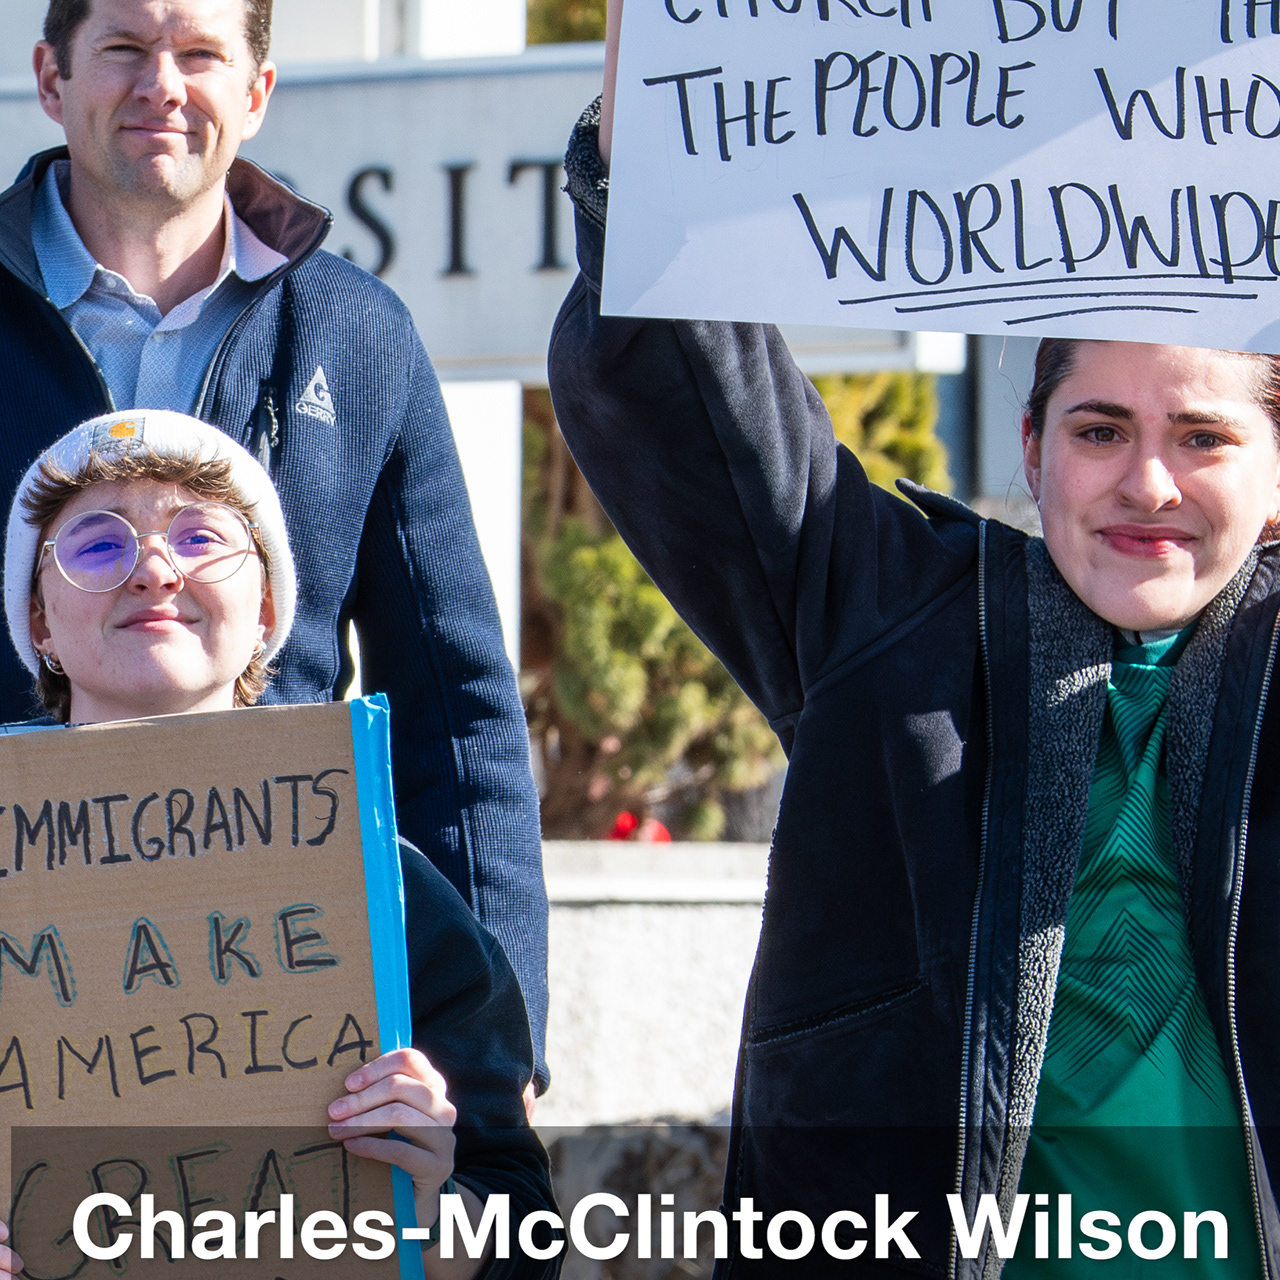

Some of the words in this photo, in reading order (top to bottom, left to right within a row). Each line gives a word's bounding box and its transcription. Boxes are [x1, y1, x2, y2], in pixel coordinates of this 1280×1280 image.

[643, 66, 796, 161] THE
[814, 50, 1036, 137] PEOPLE
[1094, 66, 1280, 144] WHO
[295, 402, 336, 427] GERRY
